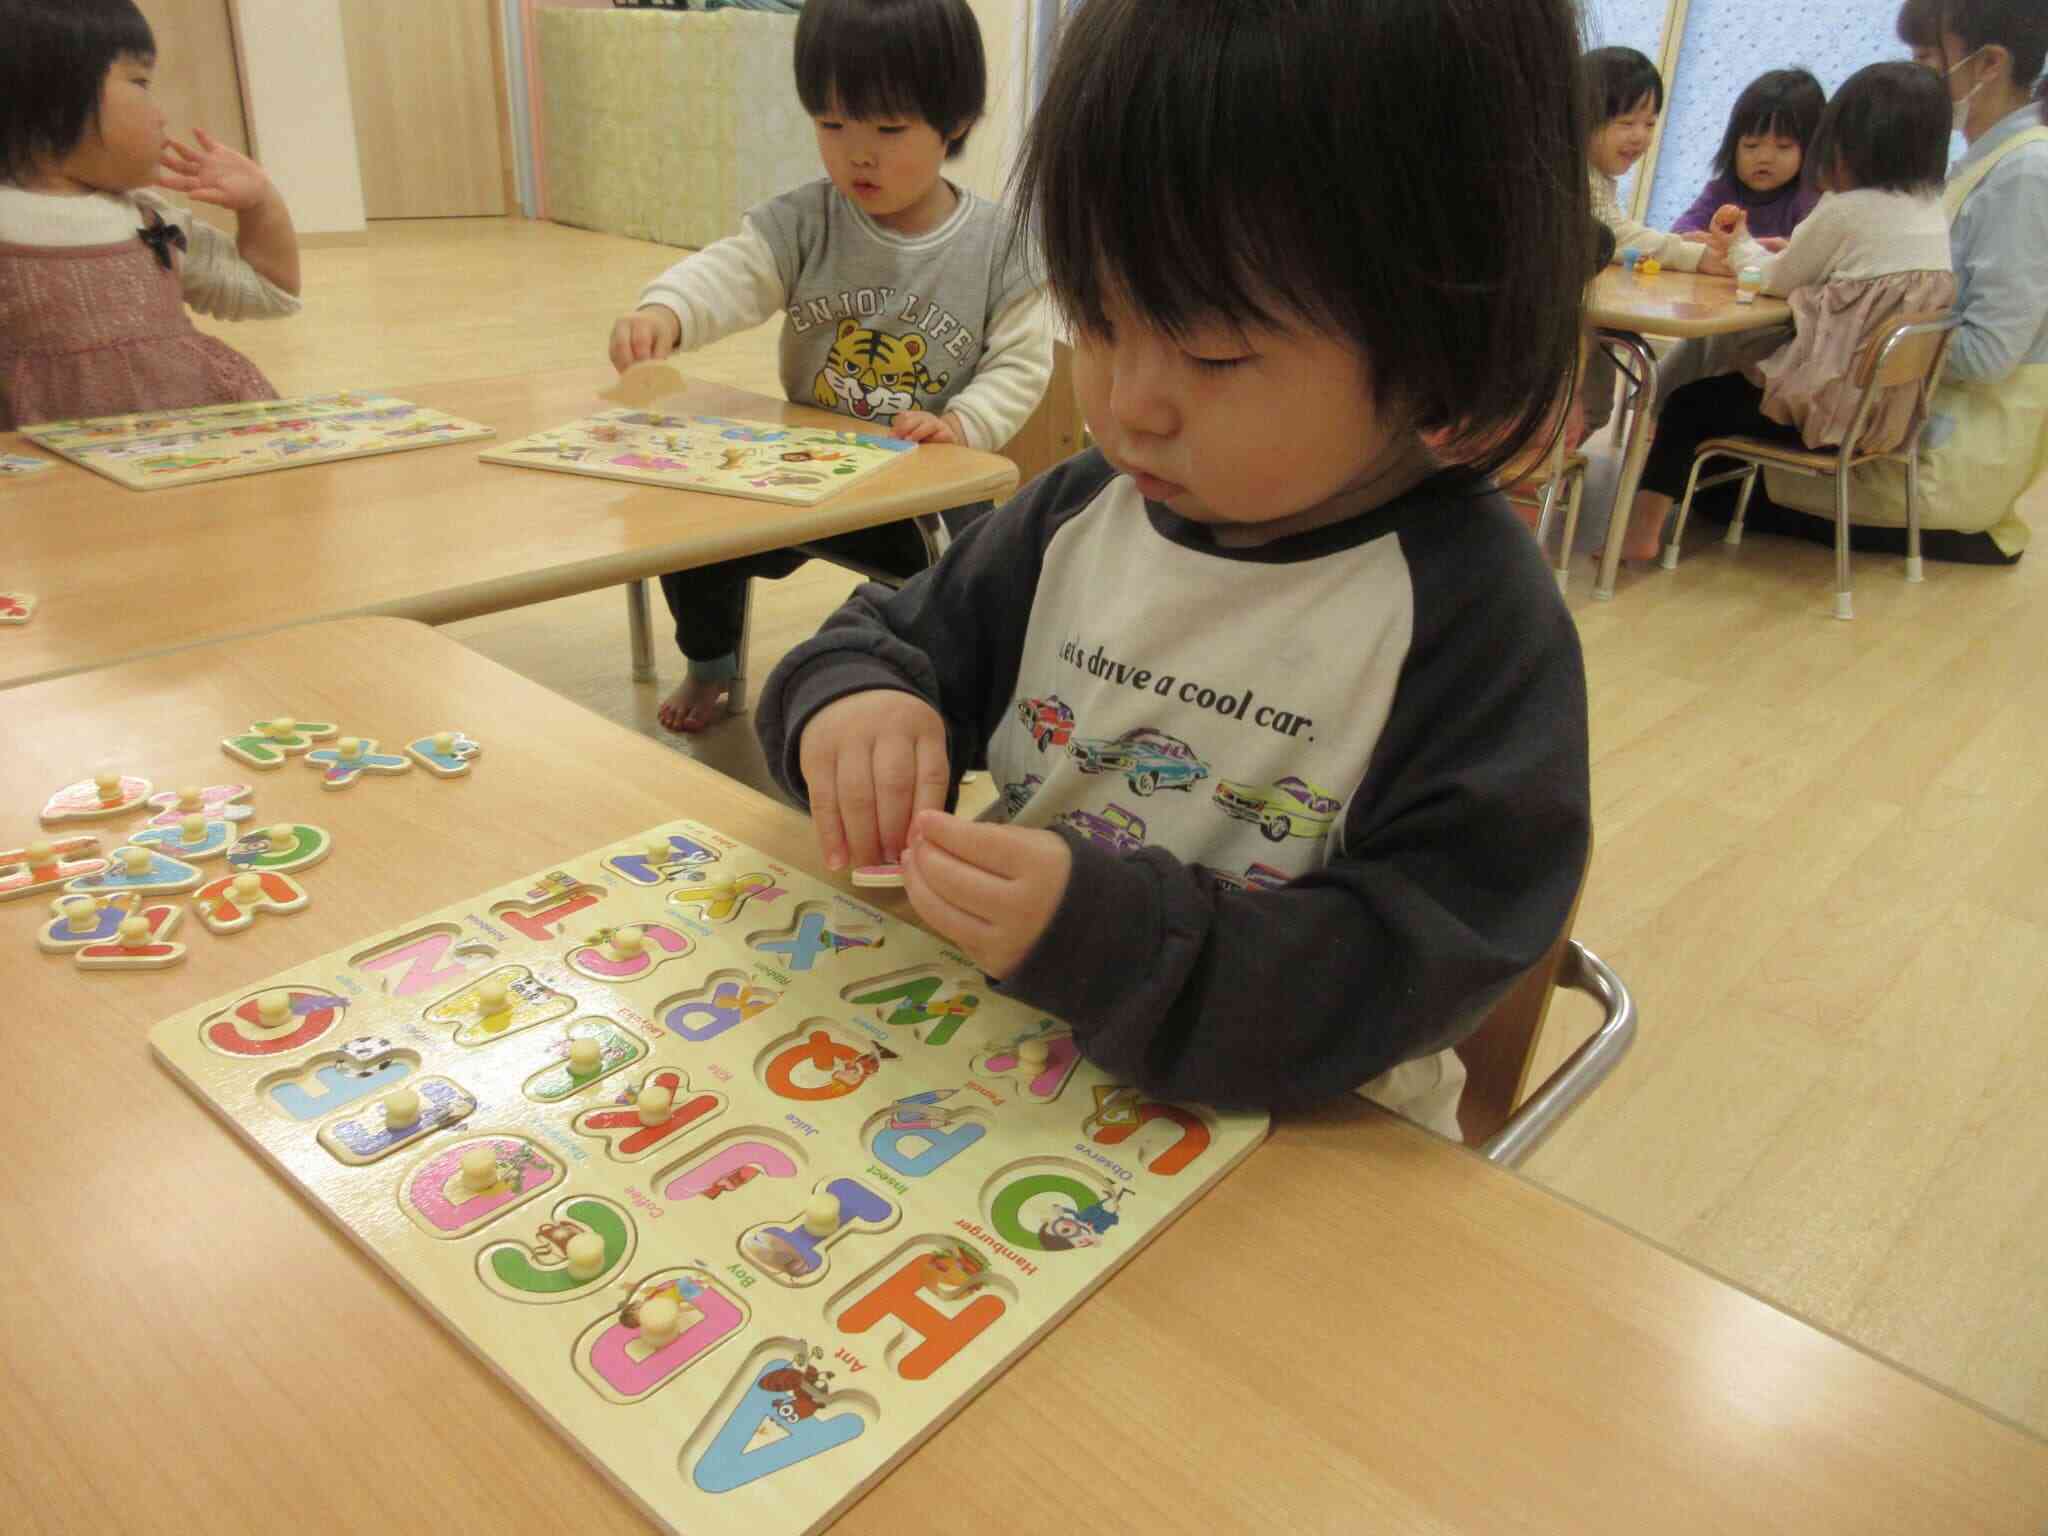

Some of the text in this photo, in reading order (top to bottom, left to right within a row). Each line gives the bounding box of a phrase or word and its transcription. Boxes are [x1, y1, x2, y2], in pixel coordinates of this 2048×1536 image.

[787, 287, 896, 334] ENJOY
[1087, 645, 1152, 690] drive
[1154, 675, 1177, 697] a
[1179, 680, 1254, 721] cool
[1255, 706, 1315, 743] car.
[500, 895, 600, 941] T
[673, 874, 773, 919] Y
[575, 923, 690, 977] S
[755, 911, 832, 971] X
[851, 975, 968, 1046] W
[763, 1028, 872, 1103] Q
[584, 1071, 720, 1155] K
[779, 1112, 822, 1139] Juice
[1091, 1101, 1212, 1177] U
[664, 1139, 800, 1202] J
[870, 1121, 987, 1178] P
[1070, 1142, 1137, 1182] Observe
[863, 1164, 911, 1196] Insect
[492, 1199, 628, 1294] C
[723, 1261, 759, 1289] Boy
[951, 1216, 1042, 1276] Hamburger
[835, 1252, 1008, 1382] H
[832, 1346, 868, 1374] Ant
[692, 1357, 867, 1495] A
